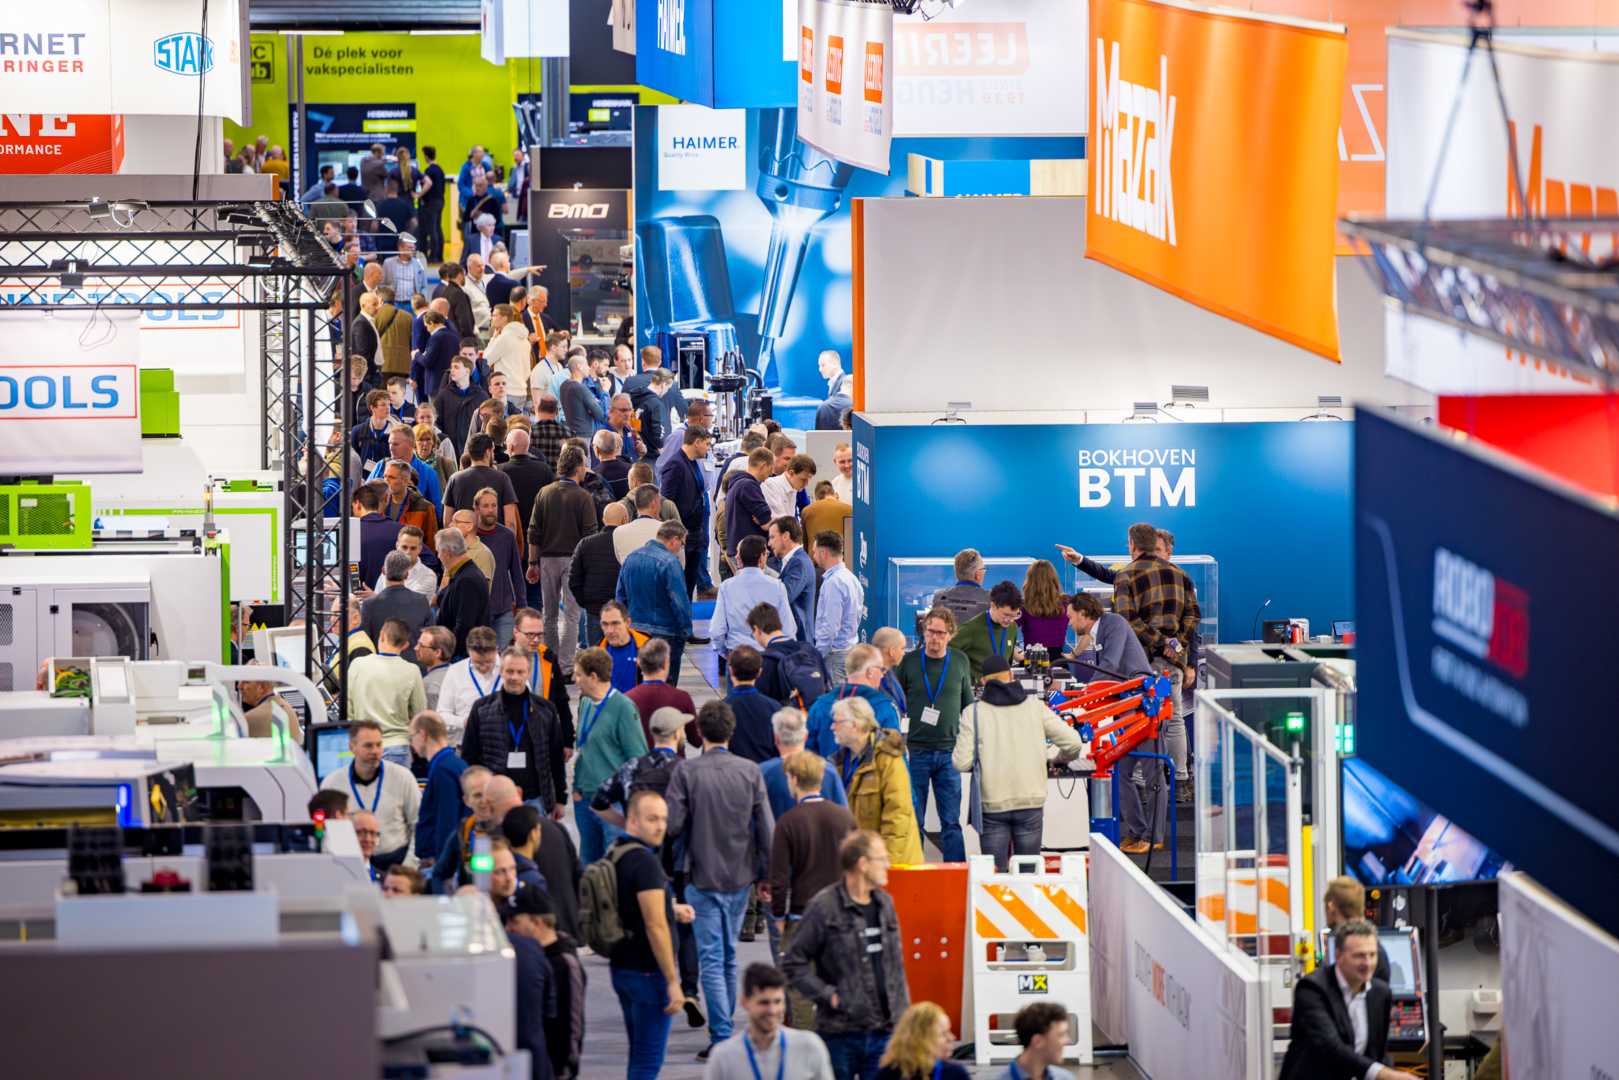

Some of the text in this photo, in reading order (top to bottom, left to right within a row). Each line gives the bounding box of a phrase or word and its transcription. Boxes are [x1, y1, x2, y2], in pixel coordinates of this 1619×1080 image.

[0, 32, 86, 55] RNET
[336, 46, 366, 60] plek
[371, 48, 403, 59] voor
[3, 60, 84, 73] RINGER
[306, 62, 414, 77] vakspecialisten
[672, 136, 737, 149] HAIMER
[1095, 37, 1177, 247] Mazak
[547, 203, 610, 219] BMO
[1078, 448, 1197, 467] BOKHOVEN
[1079, 467, 1197, 508] BTM
[1019, 975, 1048, 991] MX
